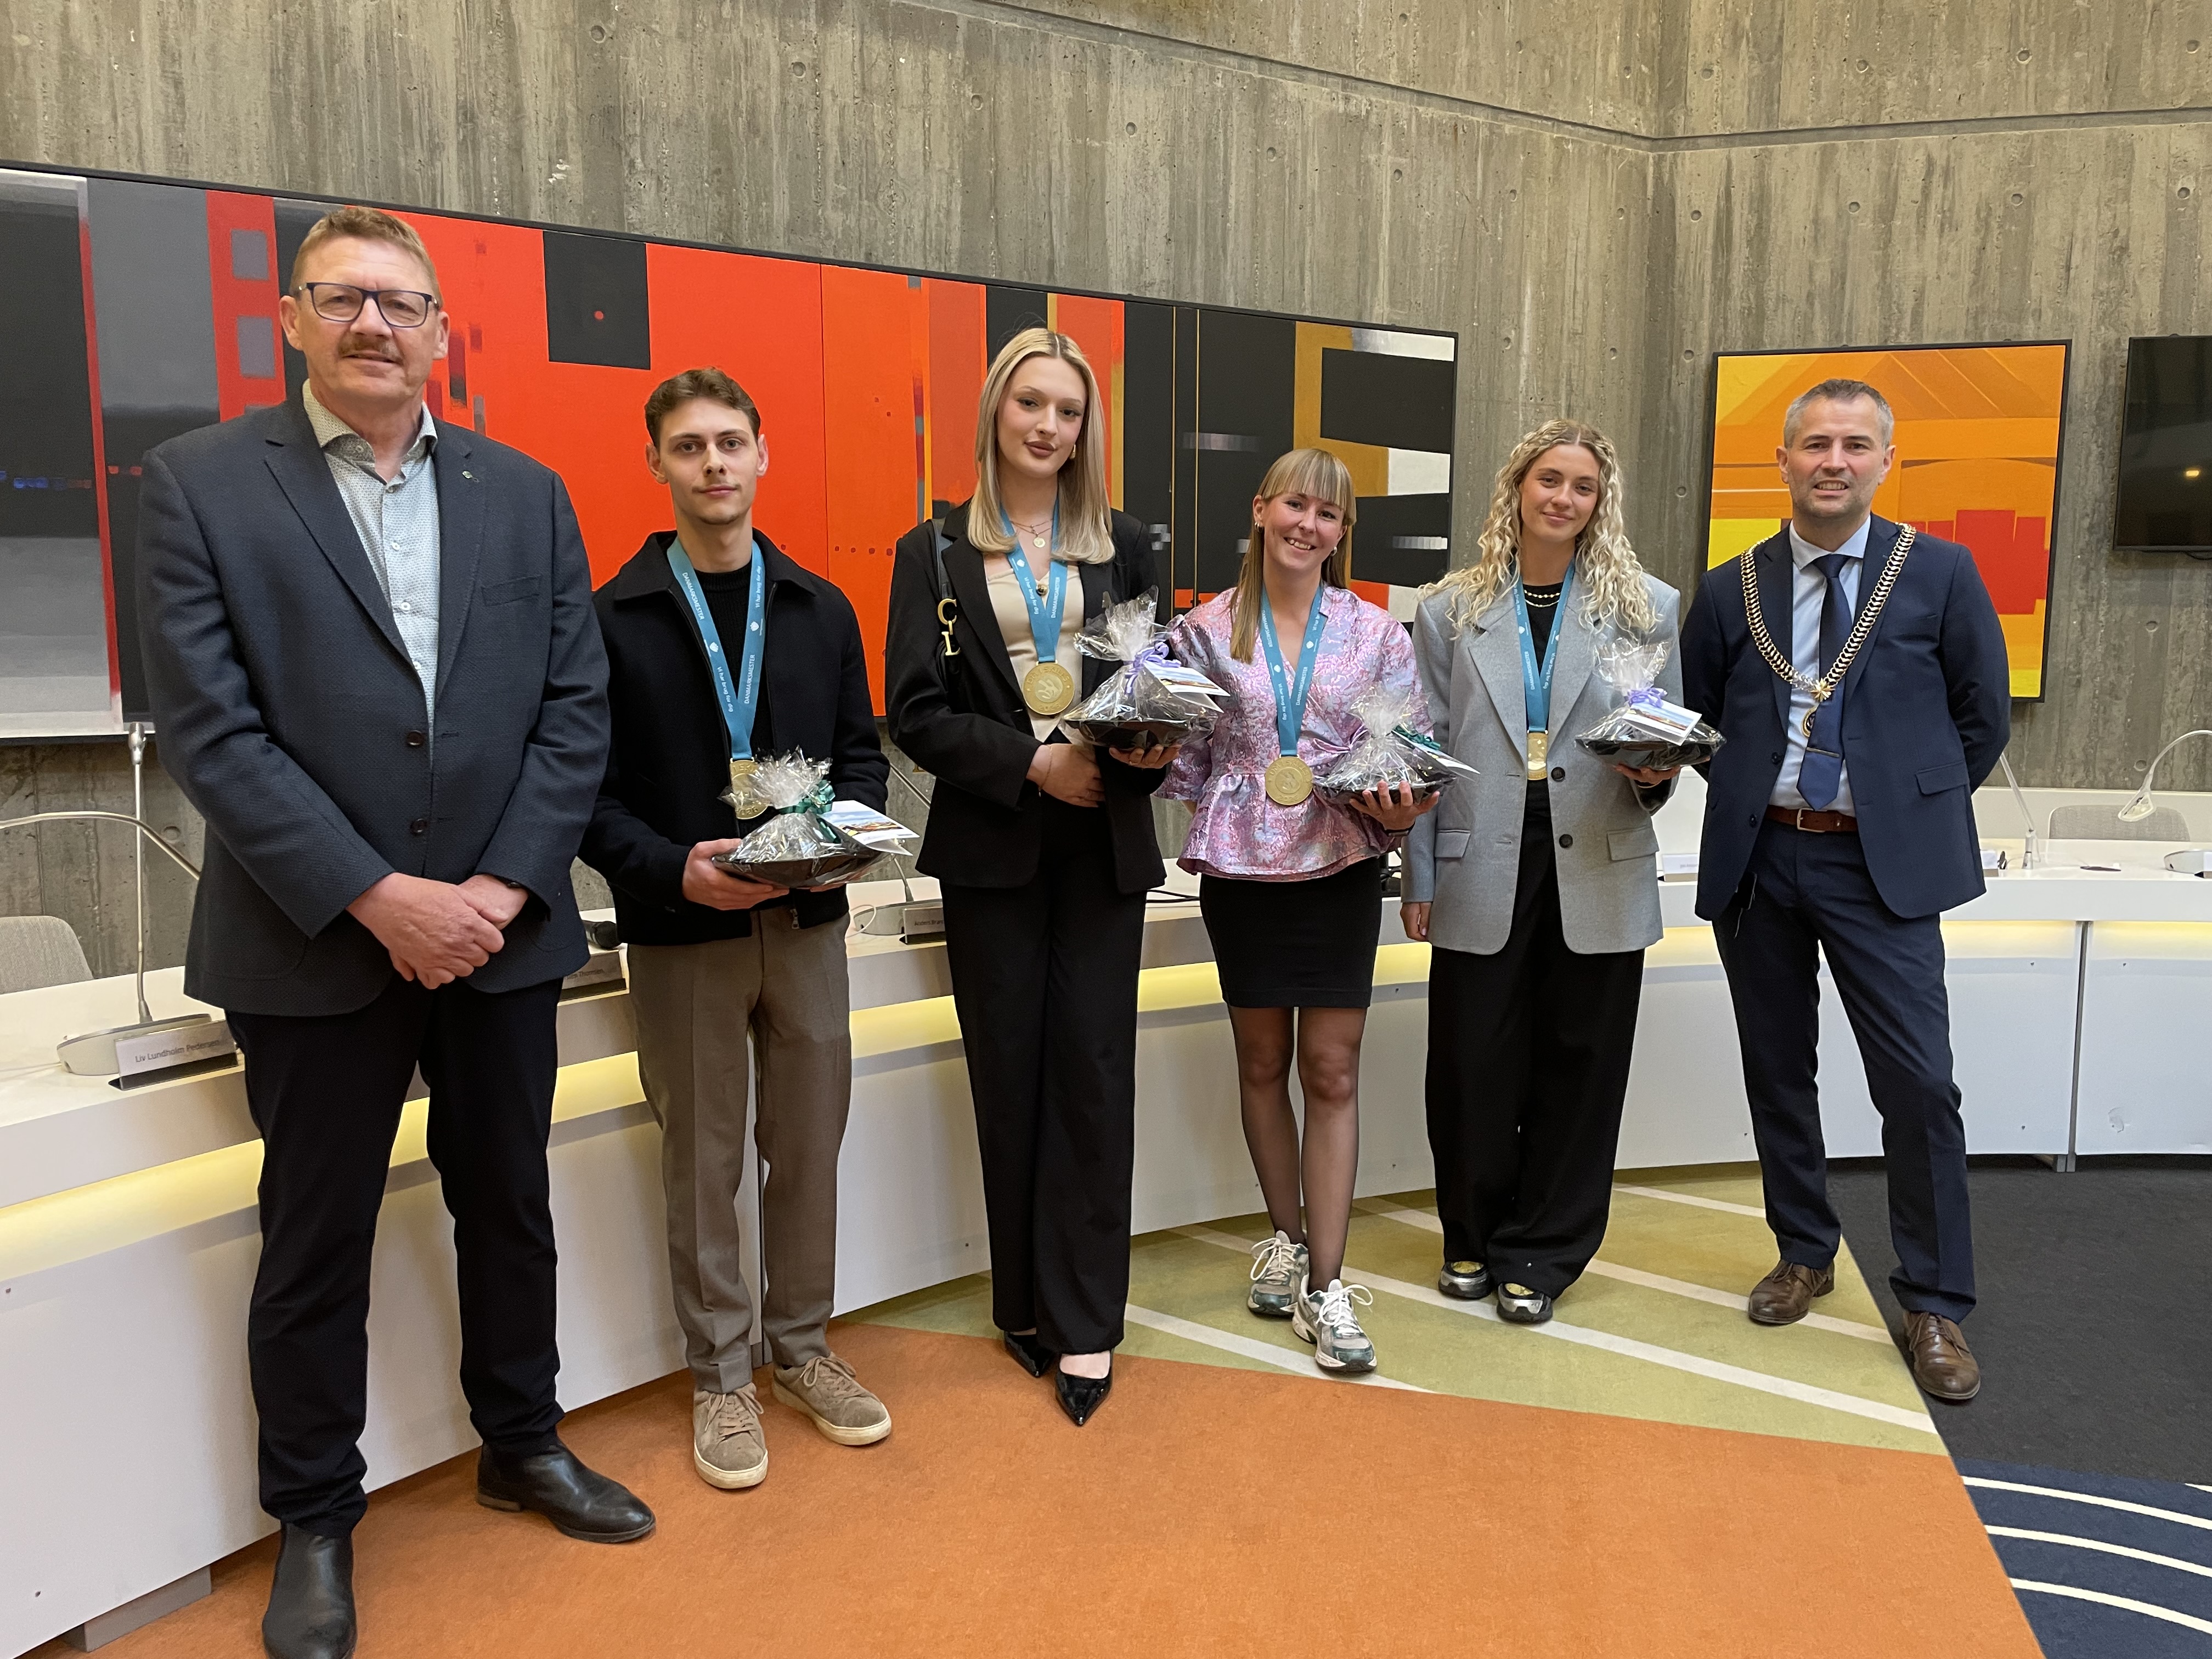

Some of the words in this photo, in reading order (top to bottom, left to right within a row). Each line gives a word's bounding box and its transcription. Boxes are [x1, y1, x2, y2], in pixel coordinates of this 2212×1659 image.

[682, 572, 705, 620] DANMARKSMESTER
[744, 654, 755, 704] DANMARKSMESTER
[135, 1054, 146, 1063] Liv
[147, 1047, 185, 1060] Lundholm
[187, 1040, 220, 1052] Pedersen
